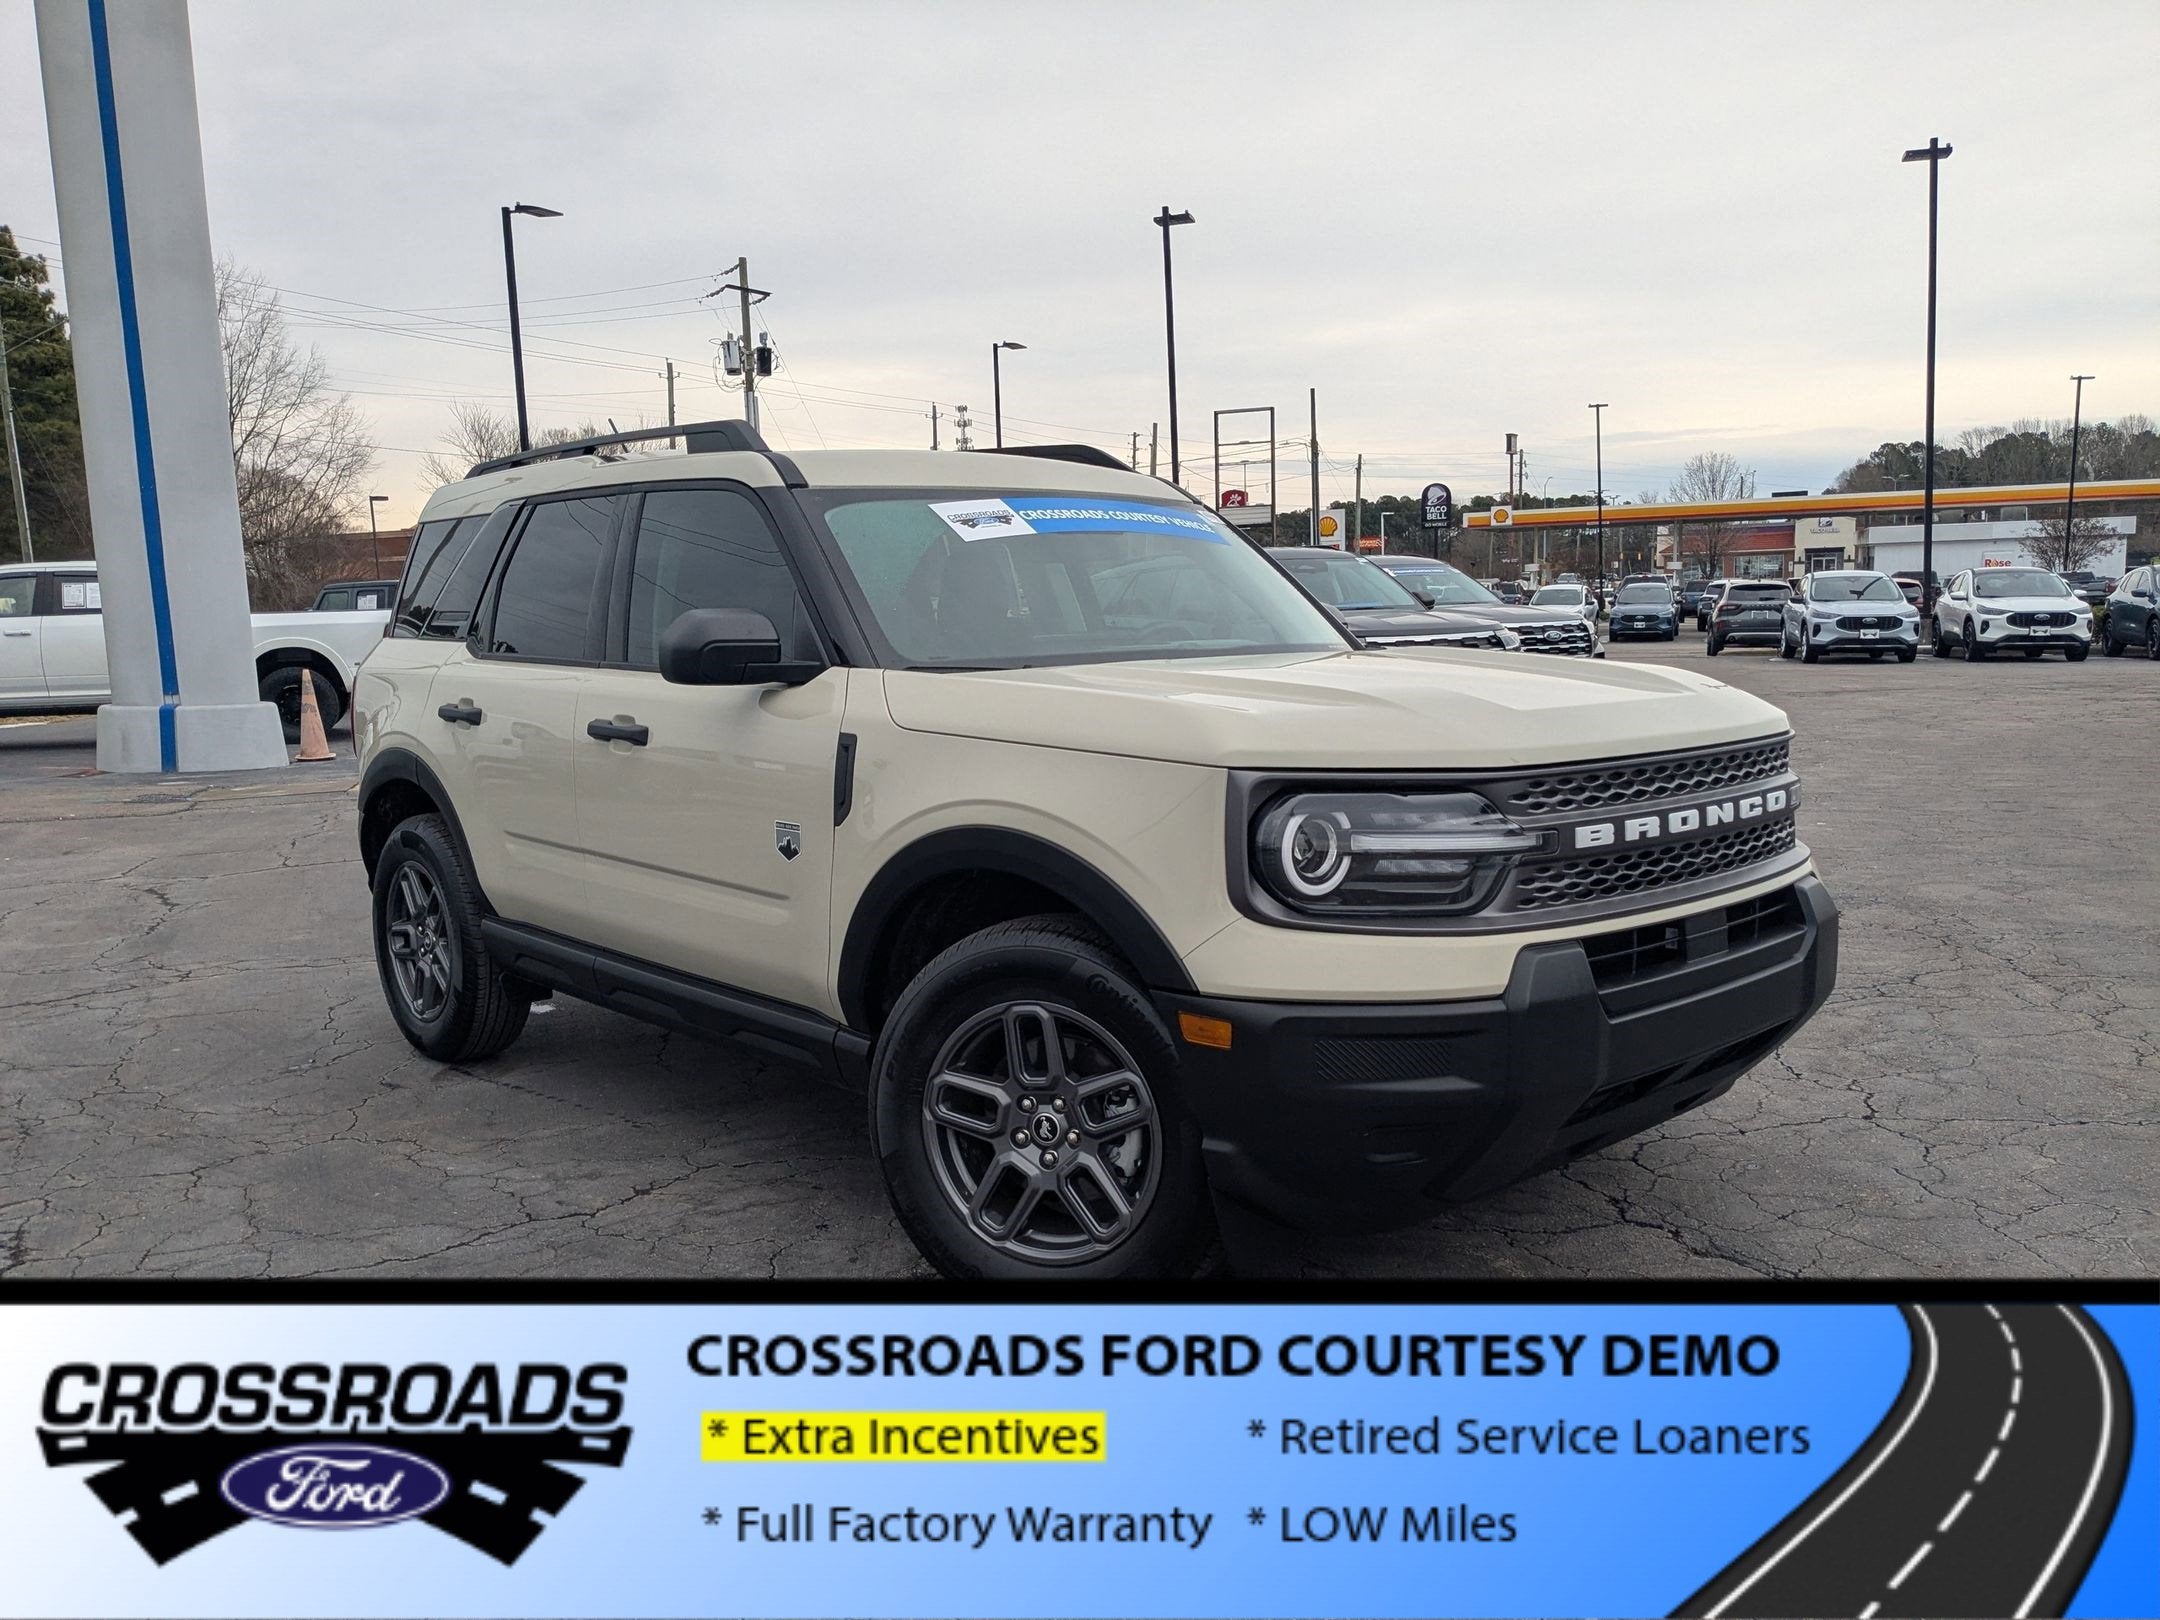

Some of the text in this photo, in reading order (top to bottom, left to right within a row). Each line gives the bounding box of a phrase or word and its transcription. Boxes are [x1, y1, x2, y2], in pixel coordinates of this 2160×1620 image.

[947, 509, 1011, 521] CROSSROADS
[1425, 505, 1447, 513] TACO
[1018, 509, 1109, 521] CROSSROADS
[1107, 510, 1170, 525] COURTESY
[1426, 512, 1447, 520] BELL
[1574, 790, 1787, 849] BRONCO
